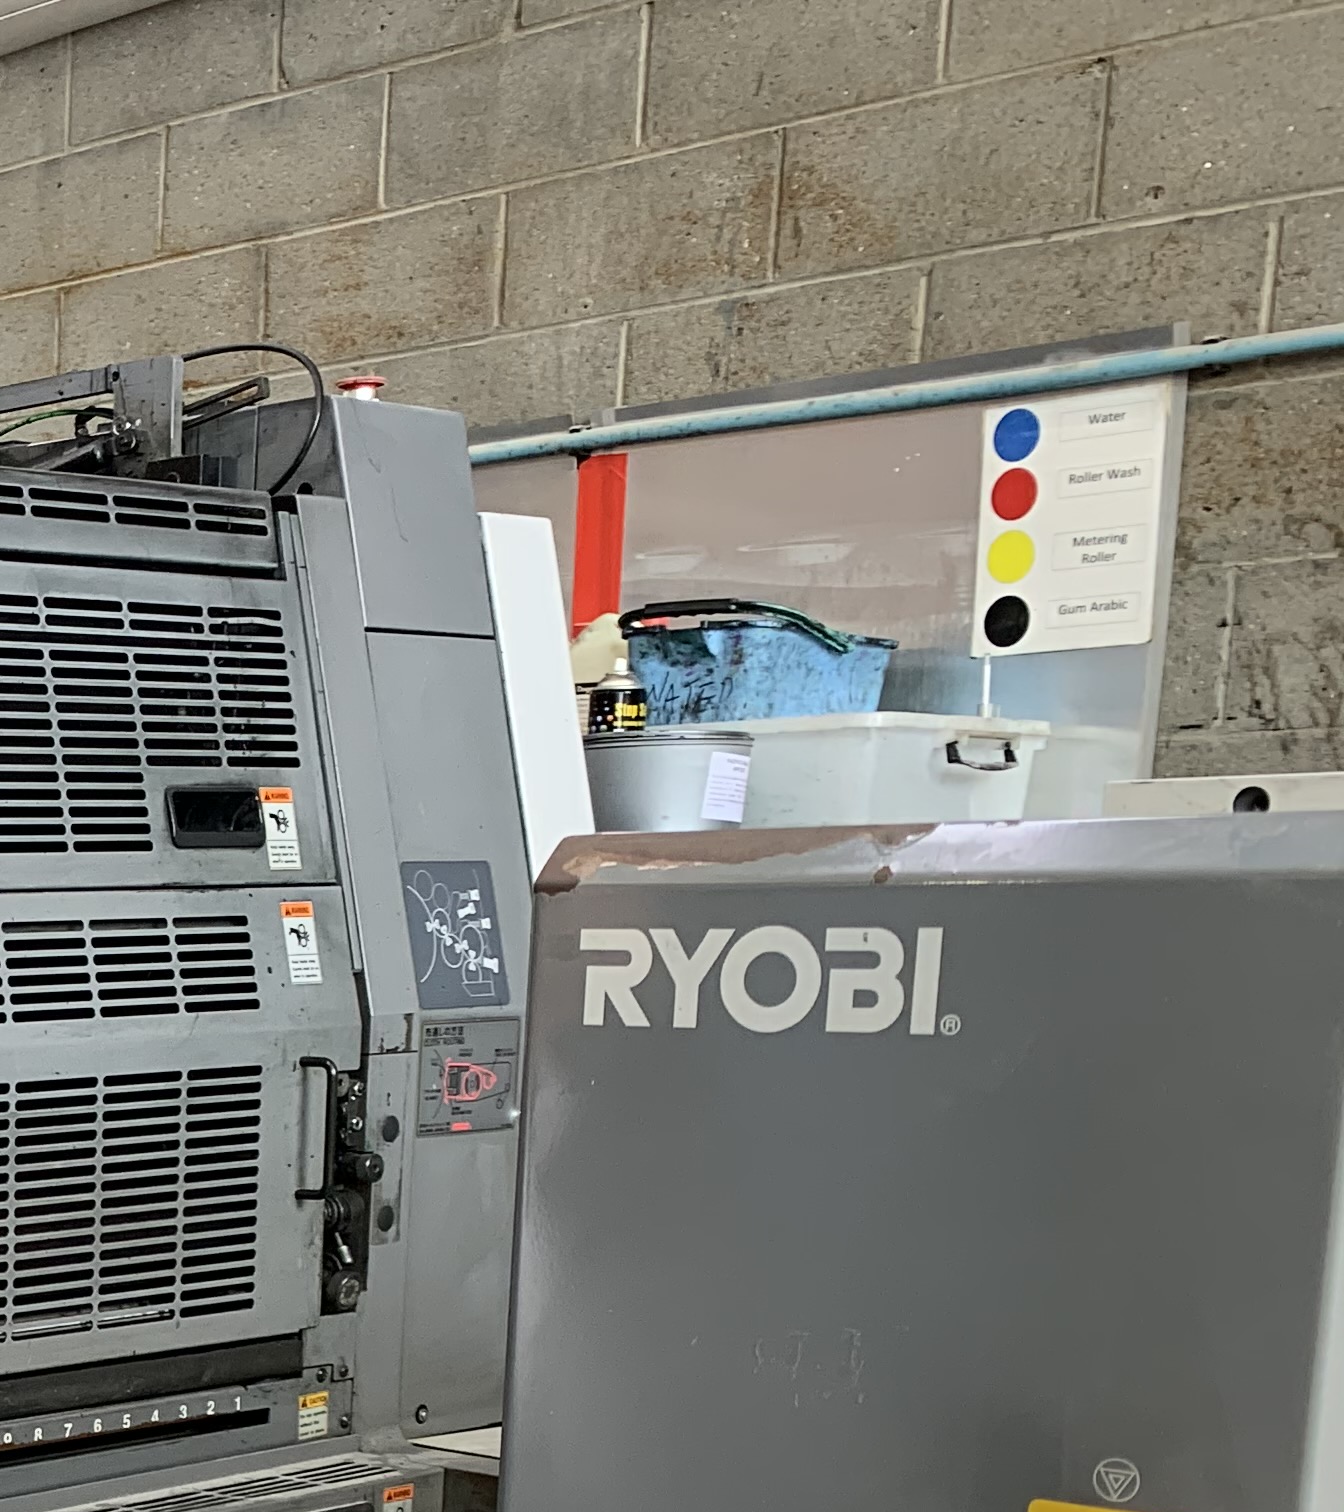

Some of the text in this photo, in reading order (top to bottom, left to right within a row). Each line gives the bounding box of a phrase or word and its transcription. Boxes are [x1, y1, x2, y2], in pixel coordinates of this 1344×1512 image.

[1088, 412, 1126, 424] Water
[1068, 465, 1141, 484] Roller Wash
[1072, 533, 1128, 547] Metering
[1081, 552, 1117, 564] Roller
[1058, 600, 1128, 615] Gum Arabic
[64, 1423, 73, 1438] 7
[93, 1418, 102, 1433] 6
[122, 1414, 131, 1429] 5
[151, 1409, 160, 1423] 4
[179, 1405, 188, 1419] 3
[207, 1400, 216, 1416] 2
[234, 1396, 242, 1411] 1
